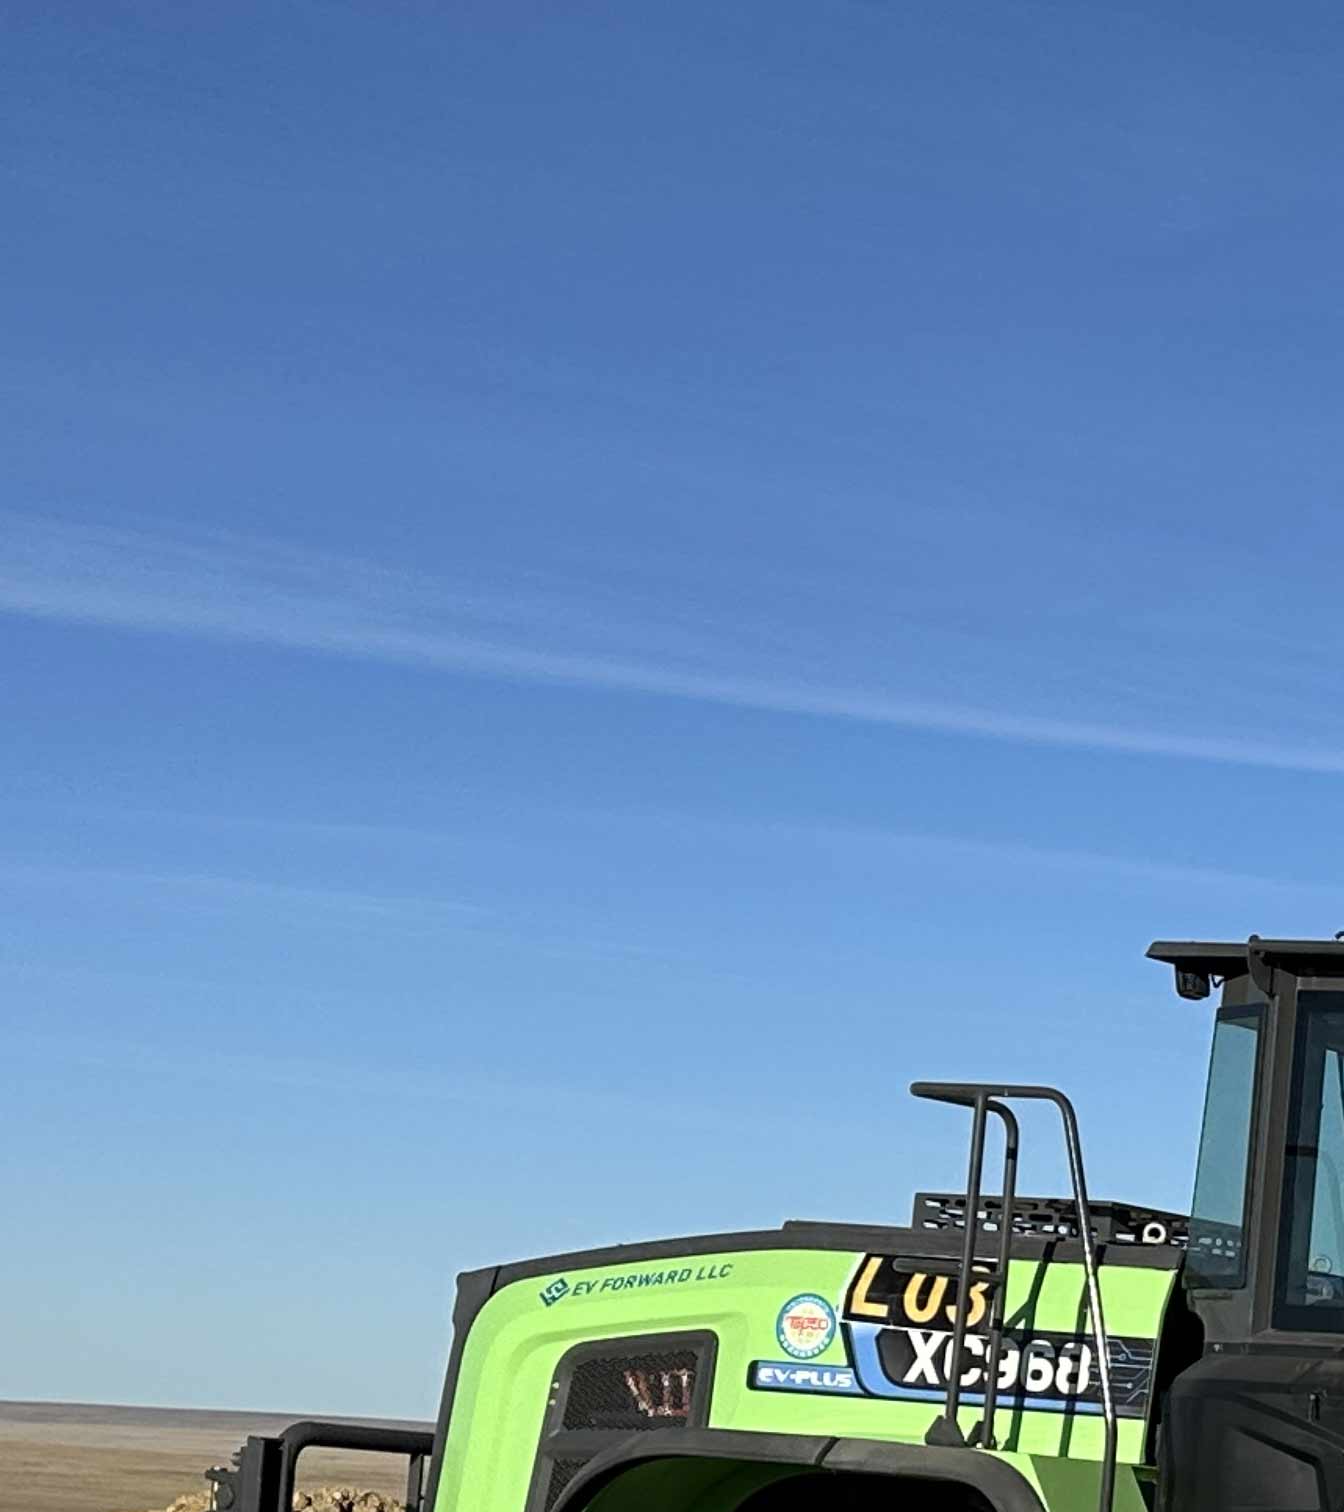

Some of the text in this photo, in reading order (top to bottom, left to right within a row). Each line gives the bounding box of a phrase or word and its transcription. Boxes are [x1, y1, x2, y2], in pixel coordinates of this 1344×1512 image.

[572, 1263, 734, 1296] EV FORWARD LLC
